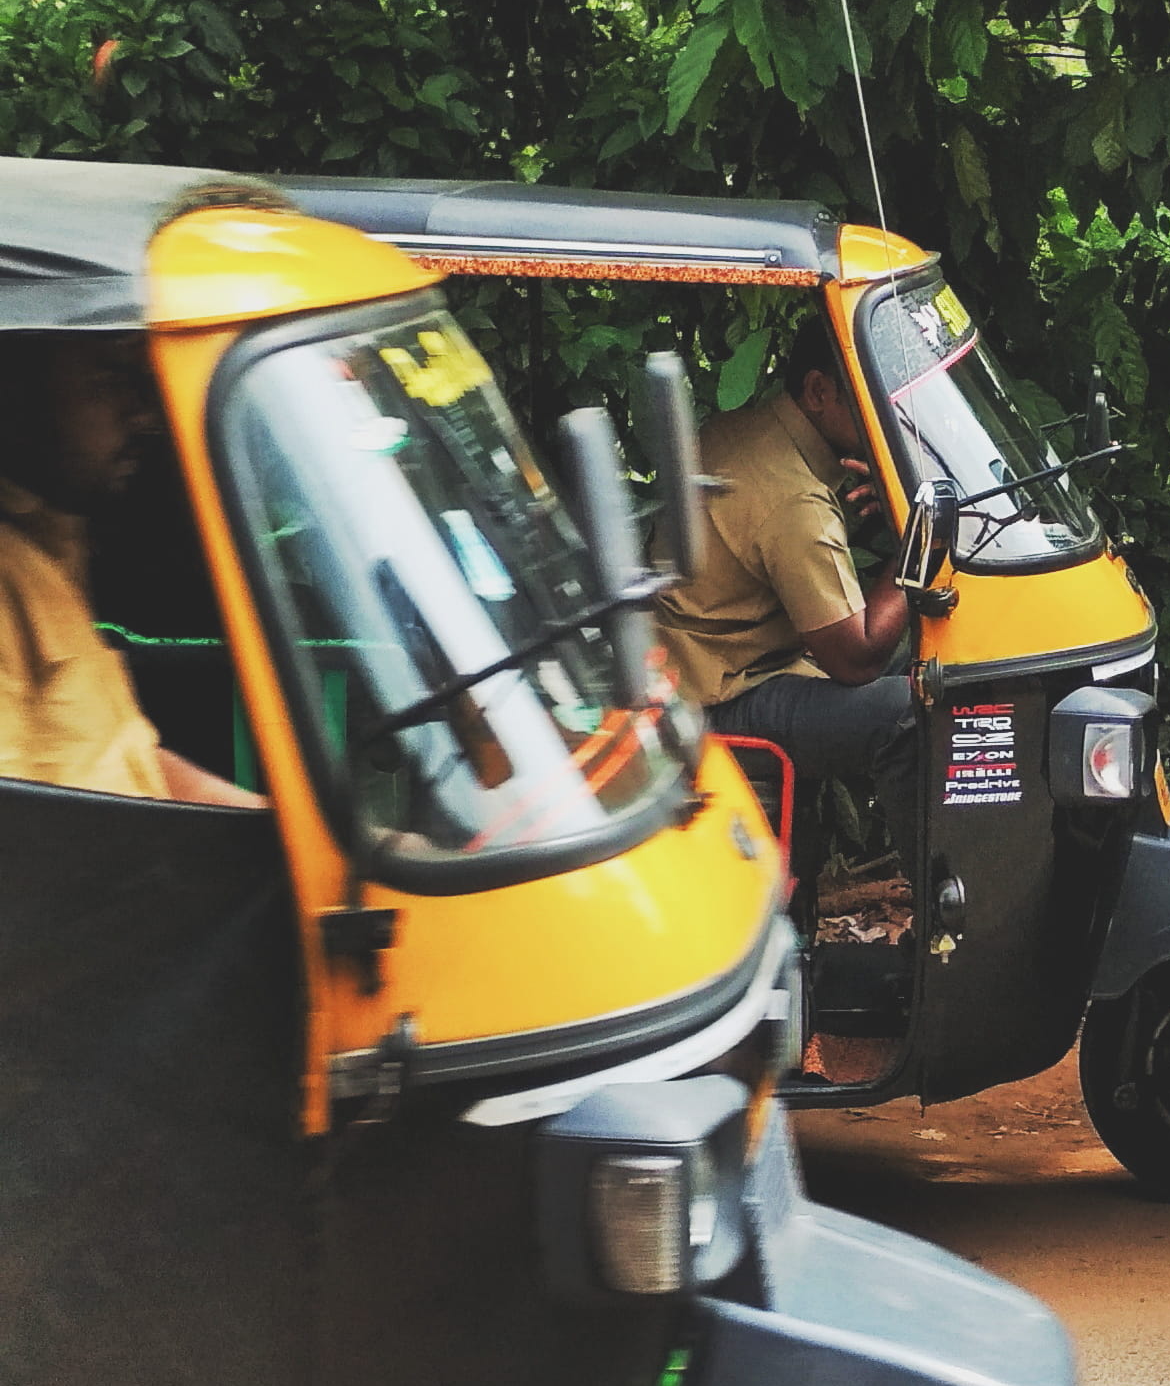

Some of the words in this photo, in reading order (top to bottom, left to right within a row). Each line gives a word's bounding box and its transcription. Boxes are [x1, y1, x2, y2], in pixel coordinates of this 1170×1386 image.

[952, 703, 1014, 715] WRC
[954, 717, 1012, 730] TRD
[943, 792, 1022, 804] BRIDGESTONE
